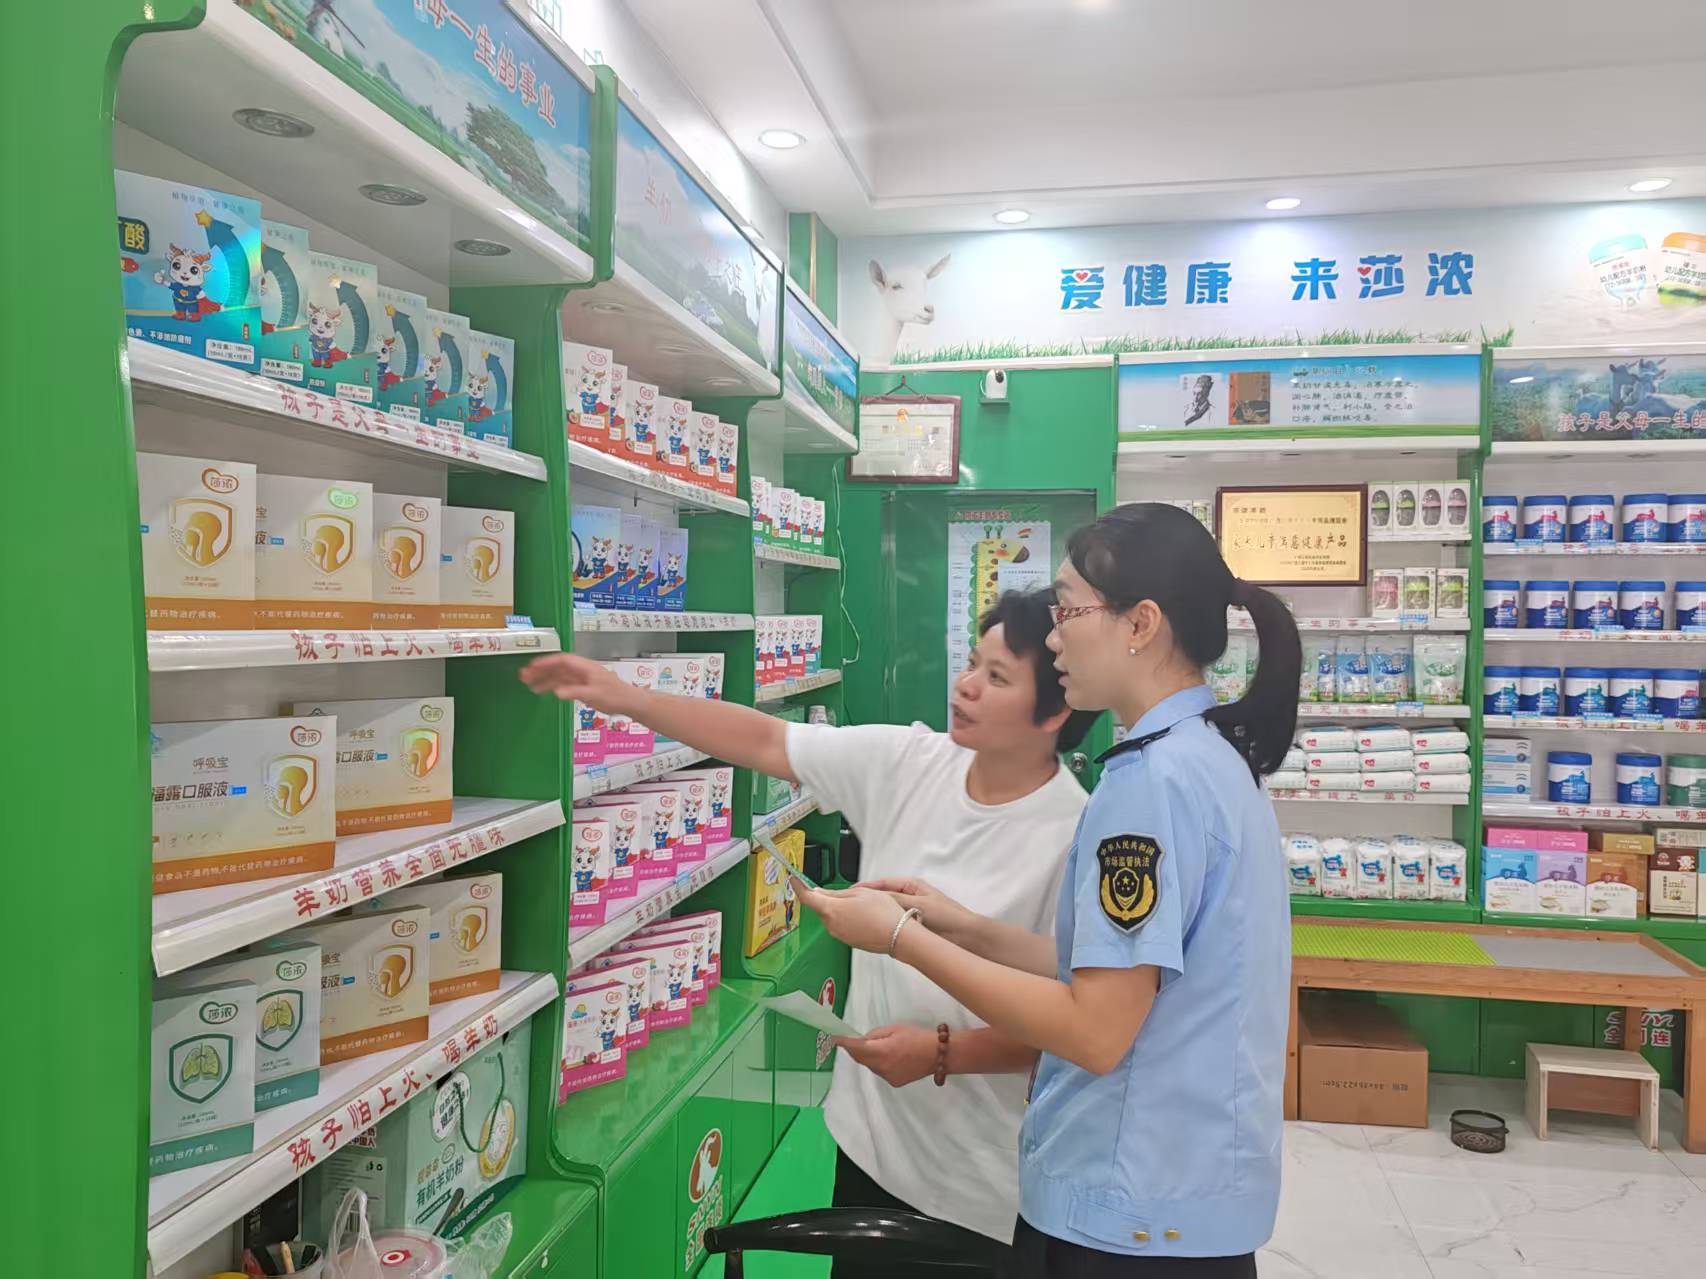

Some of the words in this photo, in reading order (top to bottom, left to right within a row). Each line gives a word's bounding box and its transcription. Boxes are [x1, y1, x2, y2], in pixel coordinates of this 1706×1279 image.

[1060, 262, 1232, 311] 爱健康
[1290, 252, 1474, 301] 来莎浓
[192, 756, 229, 770] 呼吸宝
[1101, 840, 1155, 856] 中华人民共和国
[1104, 856, 1150, 868] 市场监管执法
[287, 1014, 499, 1174] 孩子怕上火、喝羊奶
[347, 1136, 376, 1148] 中国人
[416, 1155, 465, 1206] 有机羊奶粉
